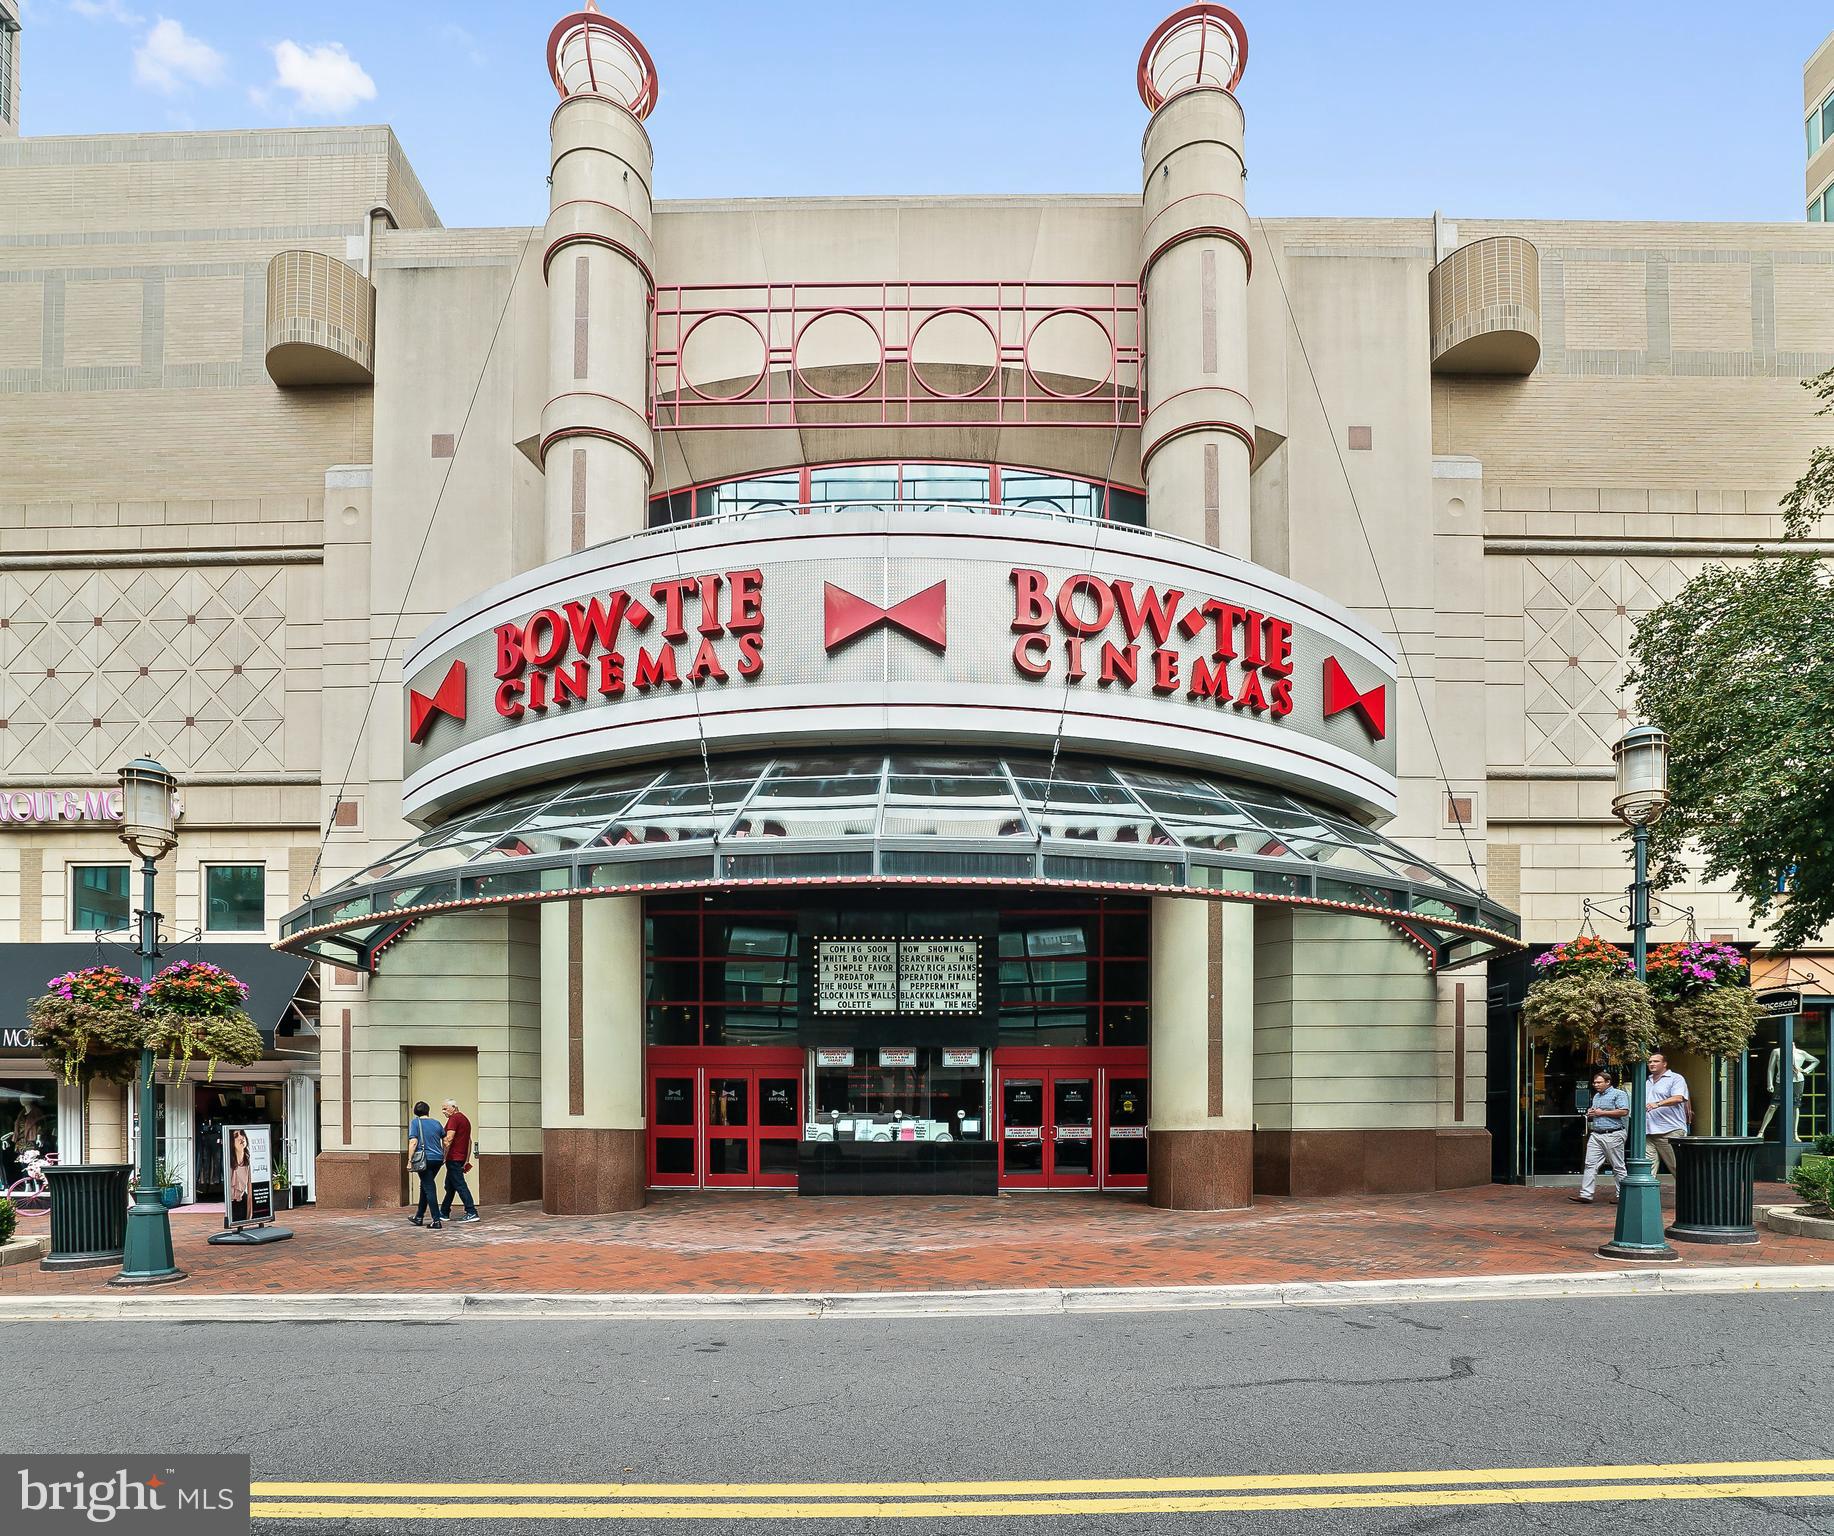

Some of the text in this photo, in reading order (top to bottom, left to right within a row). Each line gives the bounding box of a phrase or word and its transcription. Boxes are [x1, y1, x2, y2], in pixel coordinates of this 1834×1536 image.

[494, 568, 764, 681] BOW TIE
[1009, 568, 1293, 678] BOW TIE
[495, 632, 764, 719] CINEMAS
[1012, 632, 1293, 719] CINEMAS
[829, 945, 888, 953] COMING SOON
[902, 945, 965, 953] NOW SHOWING
[824, 964, 893, 972] A SIMPLE FAVOR
[900, 964, 977, 972] CRAZY RICH ASIANS
[834, 973, 875, 981] PREDATOR
[899, 973, 976, 981] OPERATION FINALE
[820, 982, 896, 990] THE HOUSE WITH A
[910, 982, 960, 990] PEPPERMINT
